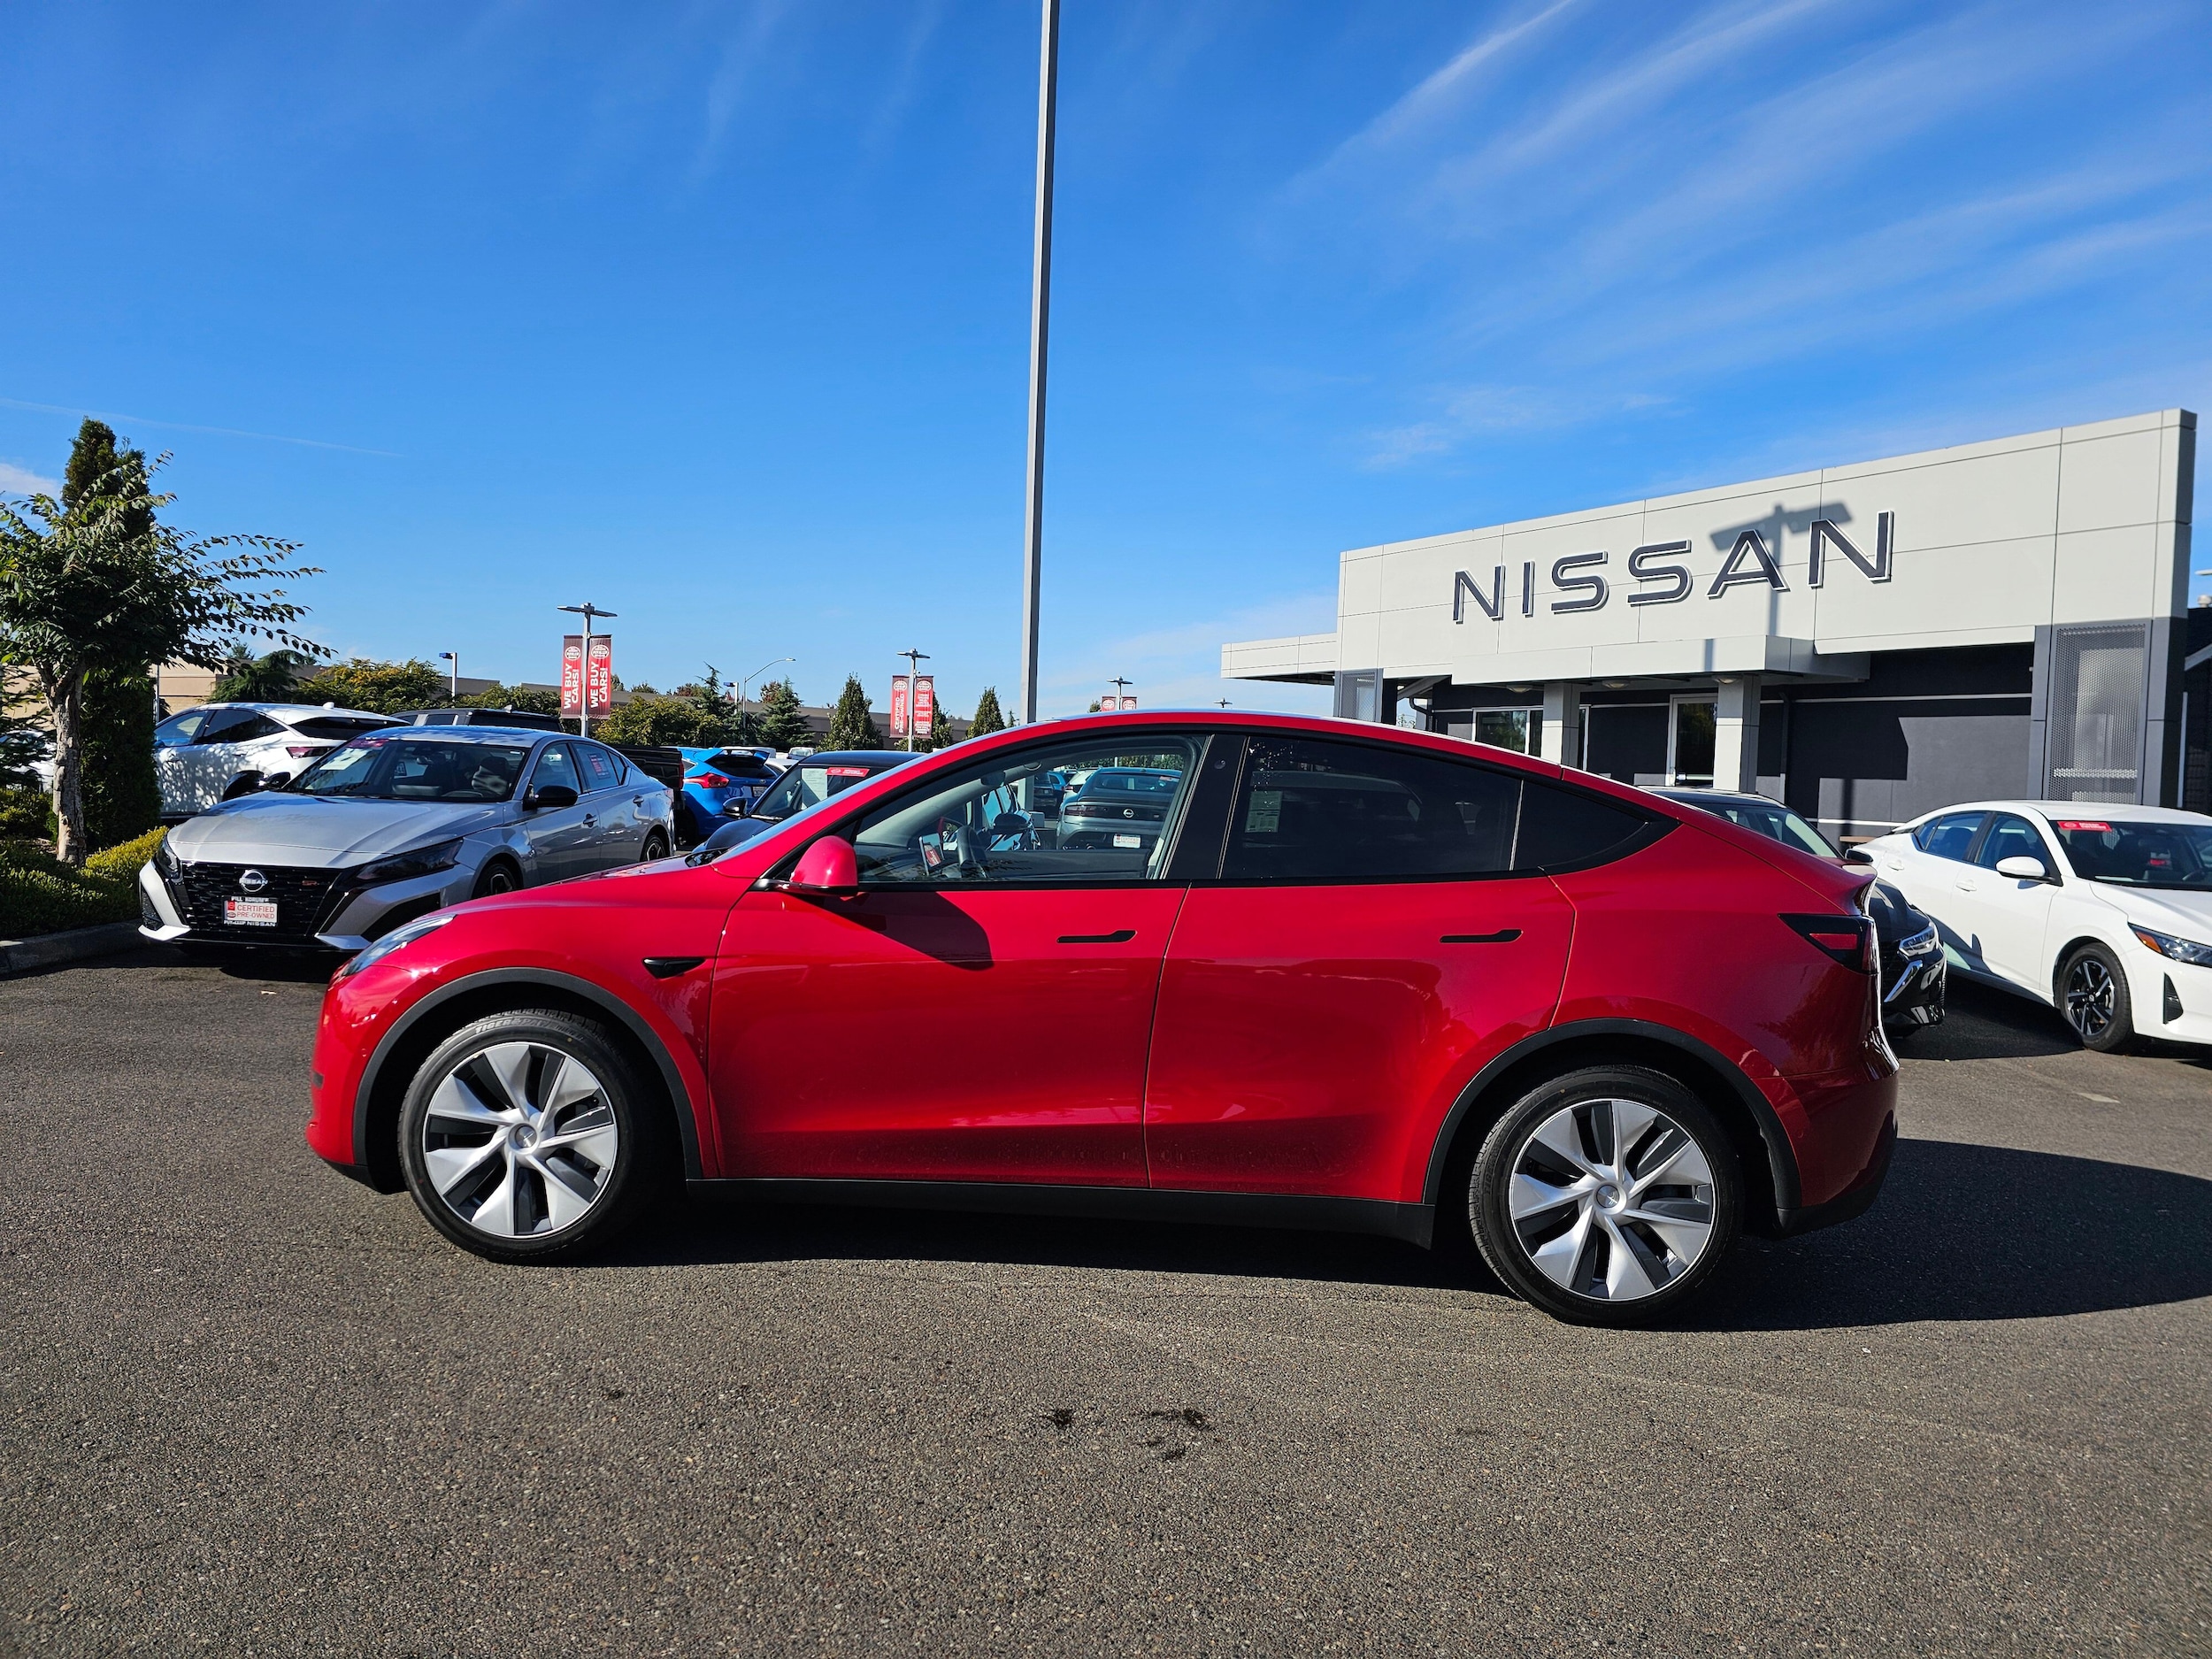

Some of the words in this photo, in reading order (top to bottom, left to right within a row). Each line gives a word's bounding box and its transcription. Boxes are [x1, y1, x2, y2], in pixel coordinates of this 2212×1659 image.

[1452, 510, 1894, 625] NISSAN
[590, 662, 599, 686] BUY
[599, 668, 608, 702] CARS!
[564, 691, 571, 709] WE
[590, 690, 598, 708] WE
[236, 904, 275, 913] CERTIFIED
[475, 1019, 512, 1033] TIGER
